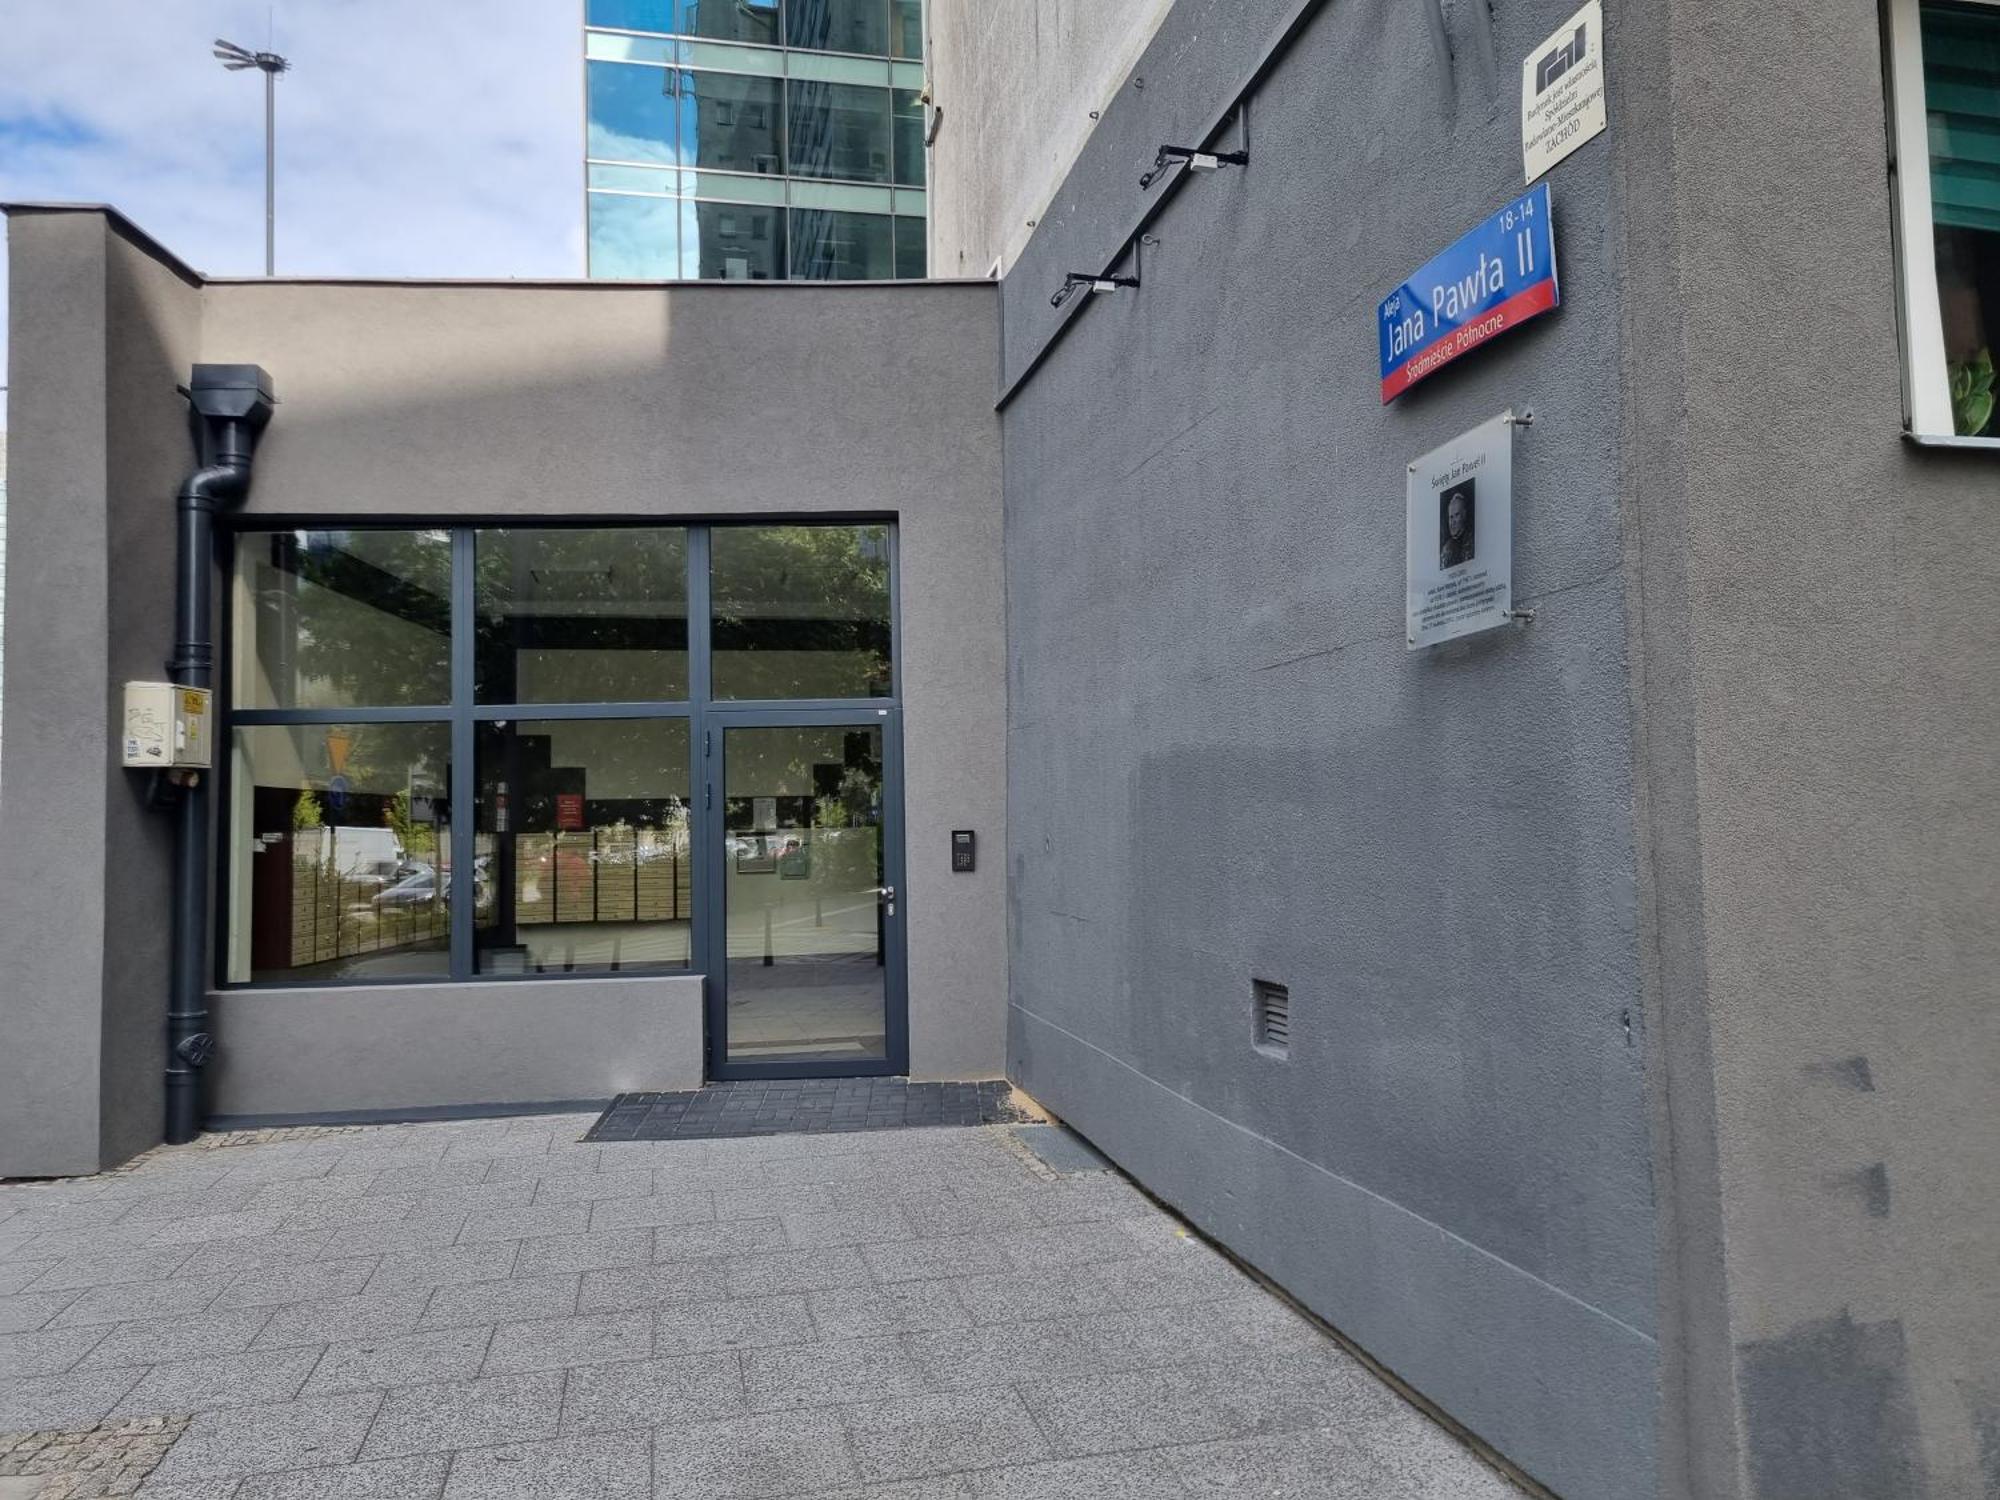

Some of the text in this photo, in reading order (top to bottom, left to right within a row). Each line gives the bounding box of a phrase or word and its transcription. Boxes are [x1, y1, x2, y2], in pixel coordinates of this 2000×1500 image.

[1545, 118, 1580, 154] ZACHÓD
[1500, 198, 1534, 234] 18-14
[1384, 296, 1400, 321] Aleja
[1388, 227, 1534, 363] Jana Pawła II
[1406, 313, 1504, 382] Śródmieście Północne
